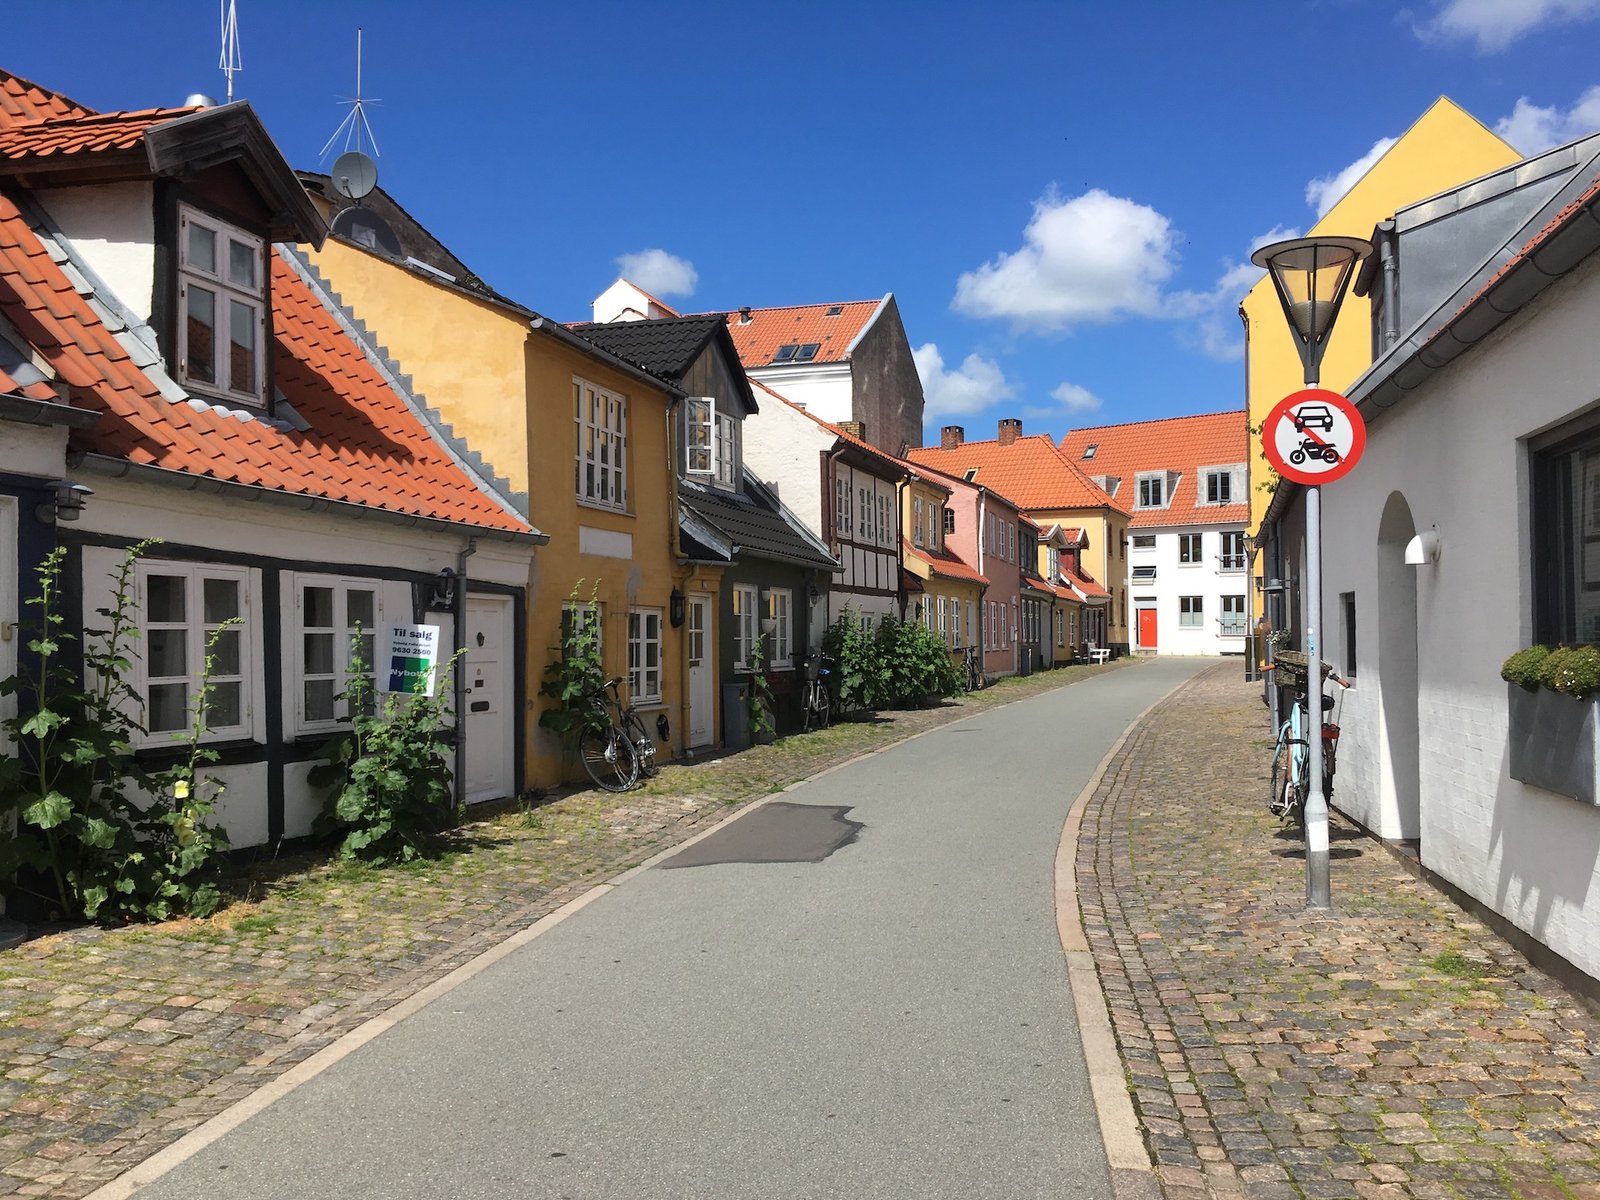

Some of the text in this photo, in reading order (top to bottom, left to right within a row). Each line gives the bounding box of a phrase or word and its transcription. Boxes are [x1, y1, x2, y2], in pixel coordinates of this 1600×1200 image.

[393, 628, 433, 641] Til salg
[412, 648, 432, 656] 2500
[391, 669, 429, 678] Nybol
